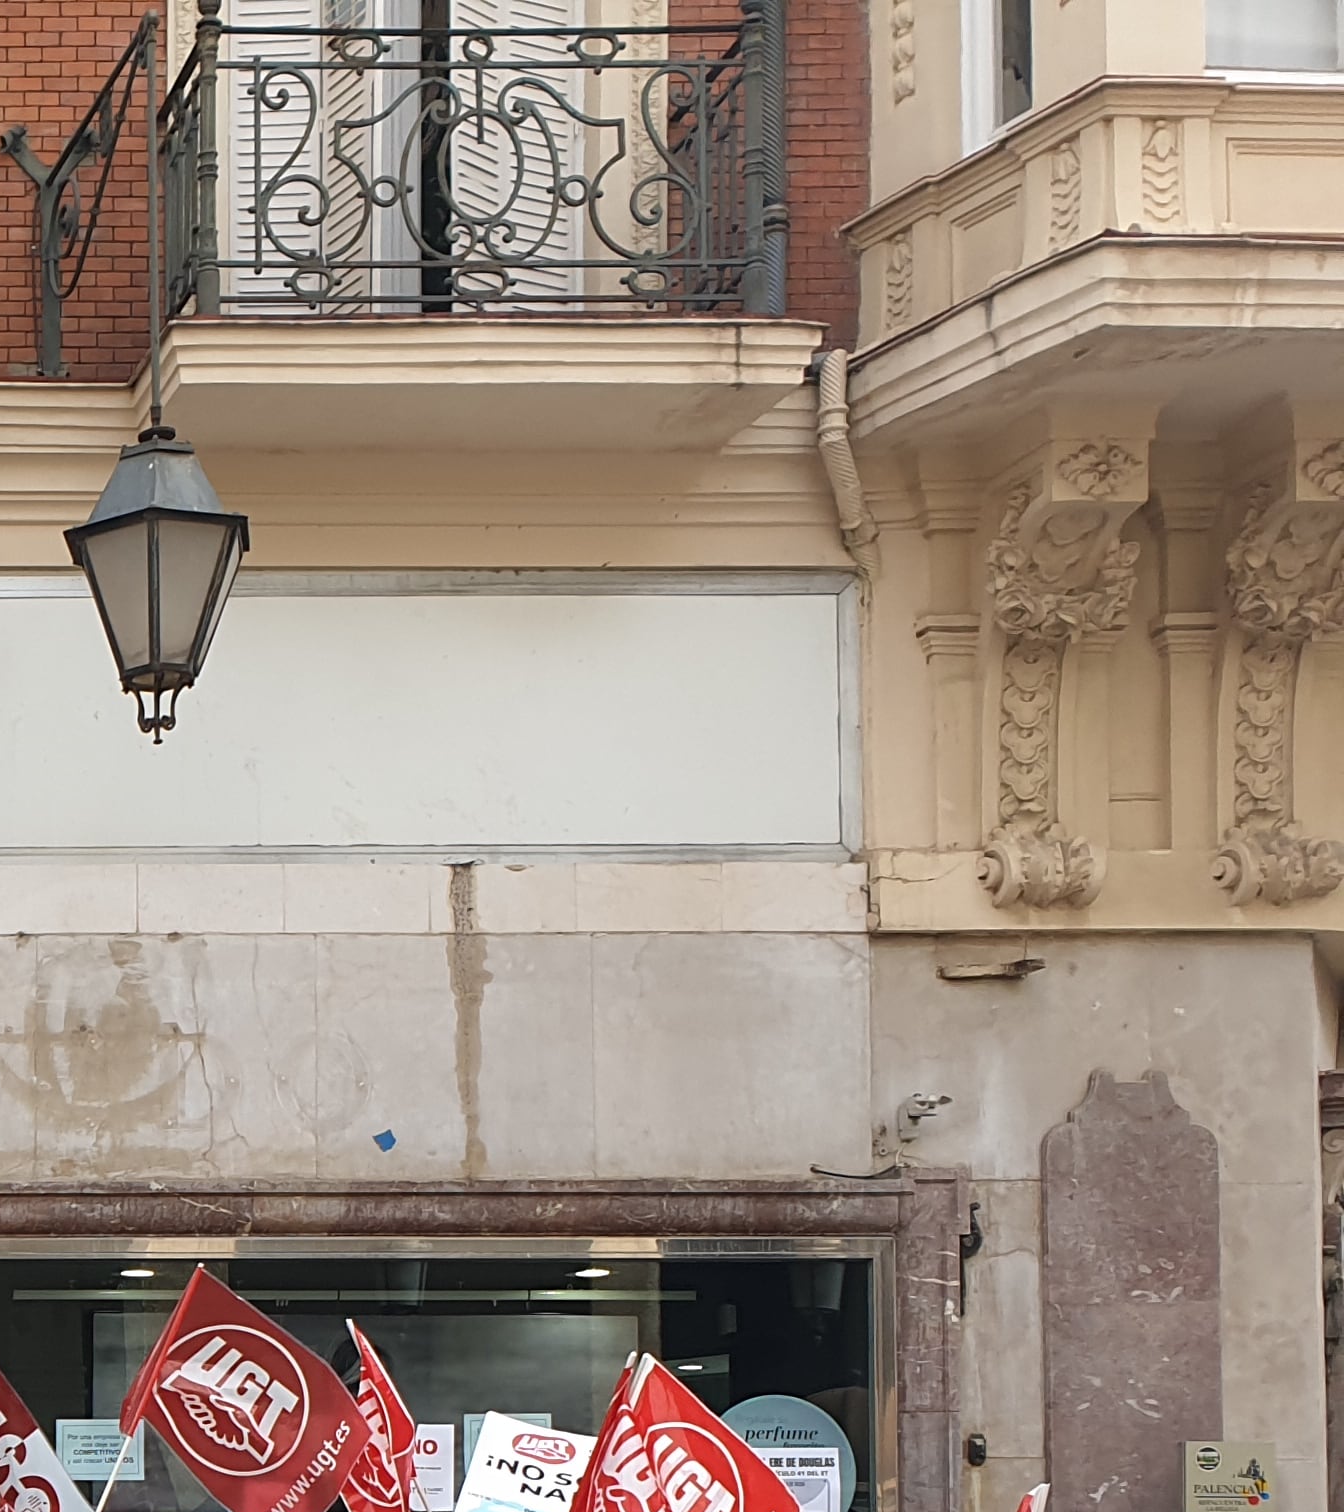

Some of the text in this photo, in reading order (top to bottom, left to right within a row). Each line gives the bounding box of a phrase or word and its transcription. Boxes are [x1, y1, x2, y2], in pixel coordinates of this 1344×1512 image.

[180, 1335, 299, 1444] UGT
[745, 1426, 819, 1442] perfume
[1194, 1485, 1255, 1494] PALENCIA
